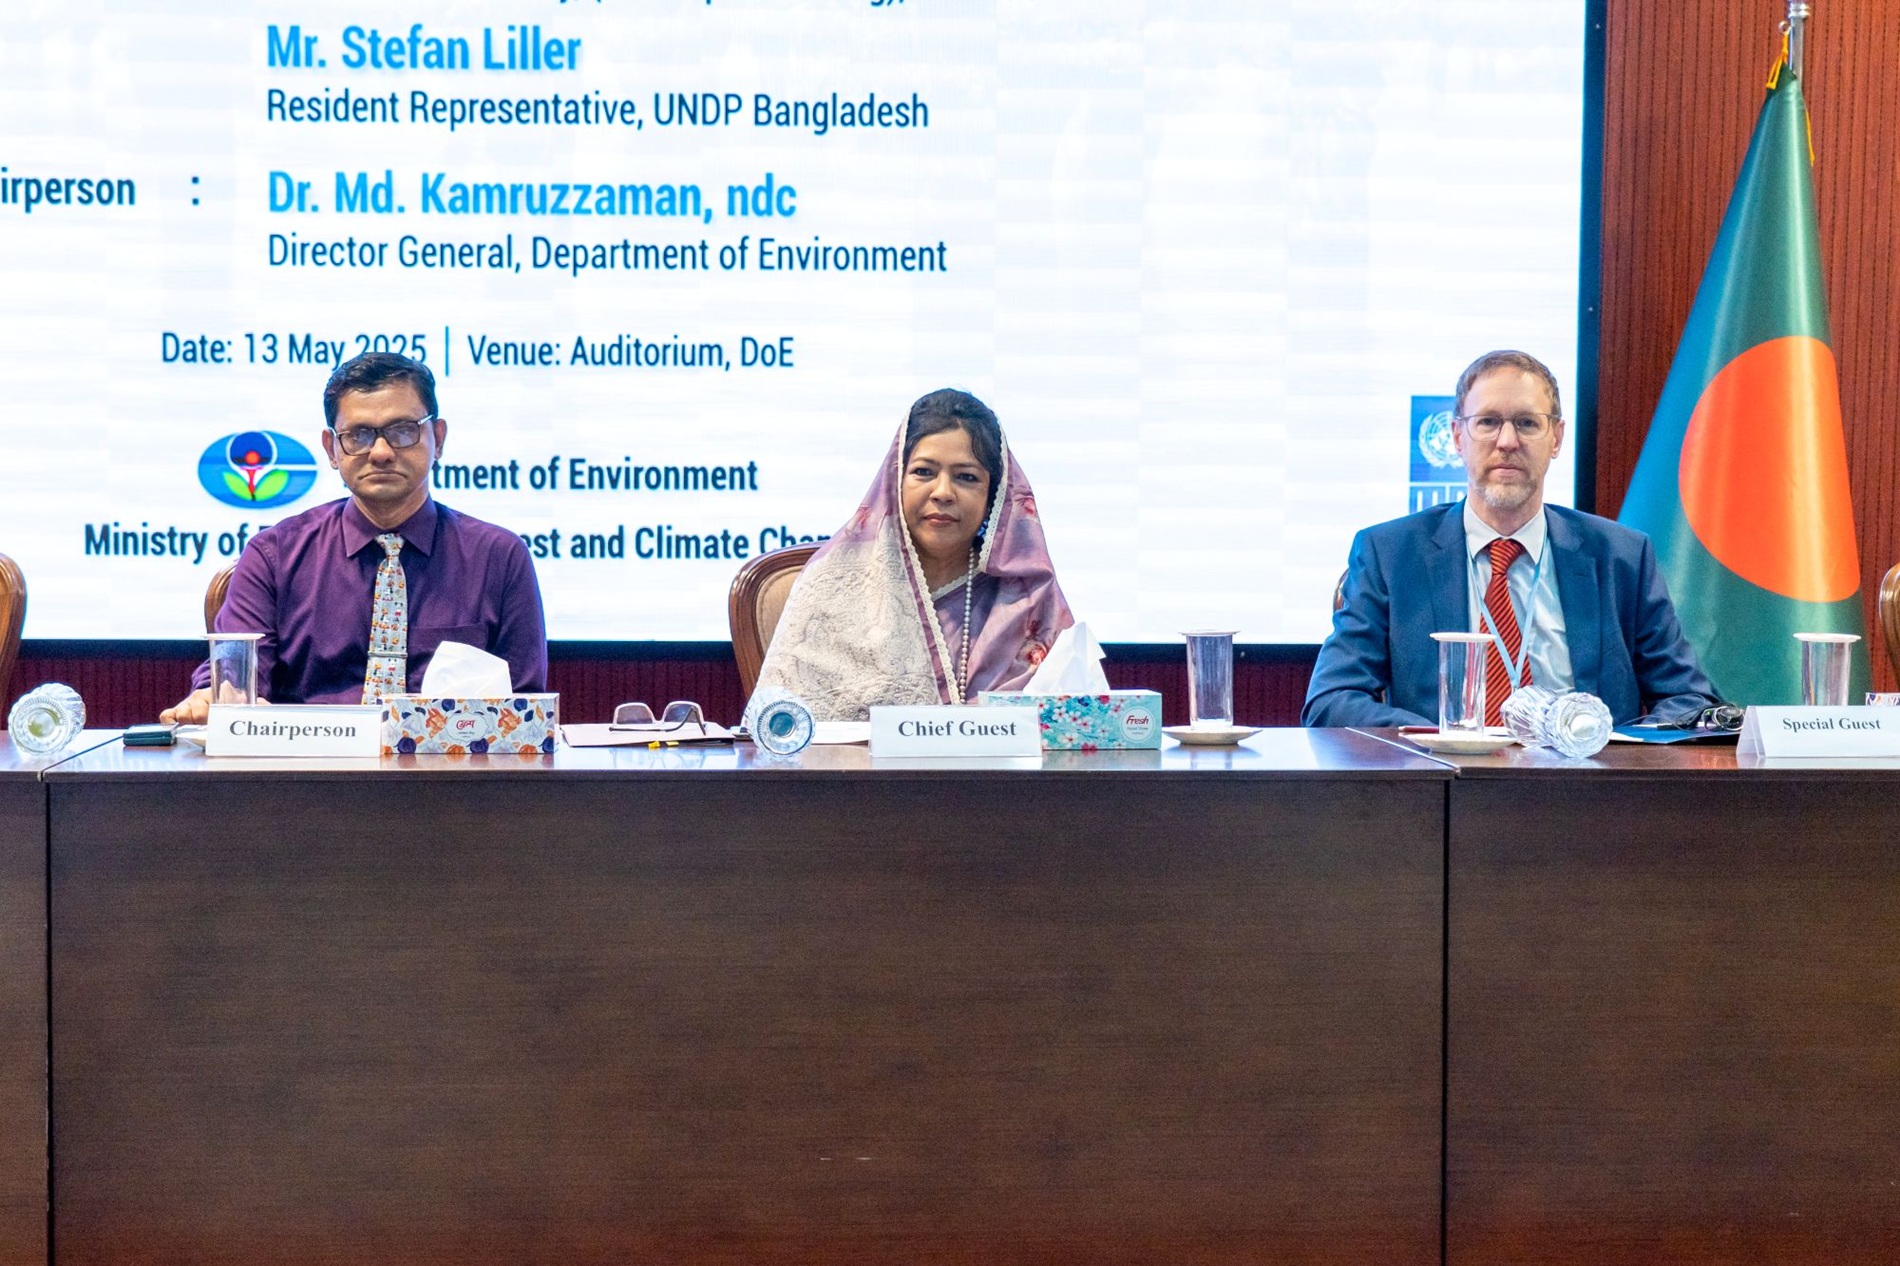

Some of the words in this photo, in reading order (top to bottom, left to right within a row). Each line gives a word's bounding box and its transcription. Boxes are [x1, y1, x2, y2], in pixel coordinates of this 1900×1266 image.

[267, 25, 327, 69] Mr.
[341, 24, 471, 71] Stefan
[483, 25, 582, 71] Liller
[267, 88, 400, 124] Resident
[410, 90, 643, 132] Representative,
[653, 93, 743, 127] UNDP
[753, 93, 929, 136] Bangladesh
[268, 170, 320, 213] Dr.
[335, 169, 406, 214] Md.
[421, 172, 713, 225] Kamruzzaman,
[727, 172, 797, 218] ndc
[268, 232, 389, 268] Director
[398, 234, 521, 274] General,
[532, 236, 710, 278] Department
[719, 236, 750, 271] of
[758, 236, 948, 273] Environment
[161, 332, 233, 365] Date:
[244, 332, 279, 365] 13
[288, 333, 346, 371] May
[467, 334, 561, 367] Venue:
[569, 334, 731, 371] Auditorium,
[740, 336, 794, 368] DoE
[529, 456, 561, 490] of
[569, 456, 759, 491] Environment
[84, 522, 209, 565] Ministry
[217, 523, 249, 556] of
[569, 525, 625, 559] and
[634, 525, 750, 560] Climate
[229, 720, 357, 740] Chairperson
[898, 720, 954, 737] Chief
[958, 720, 1017, 737] Guest
[1126, 714, 1149, 725] Fresh
[1782, 717, 1834, 733] Special
[1838, 717, 1881, 730] Guest
